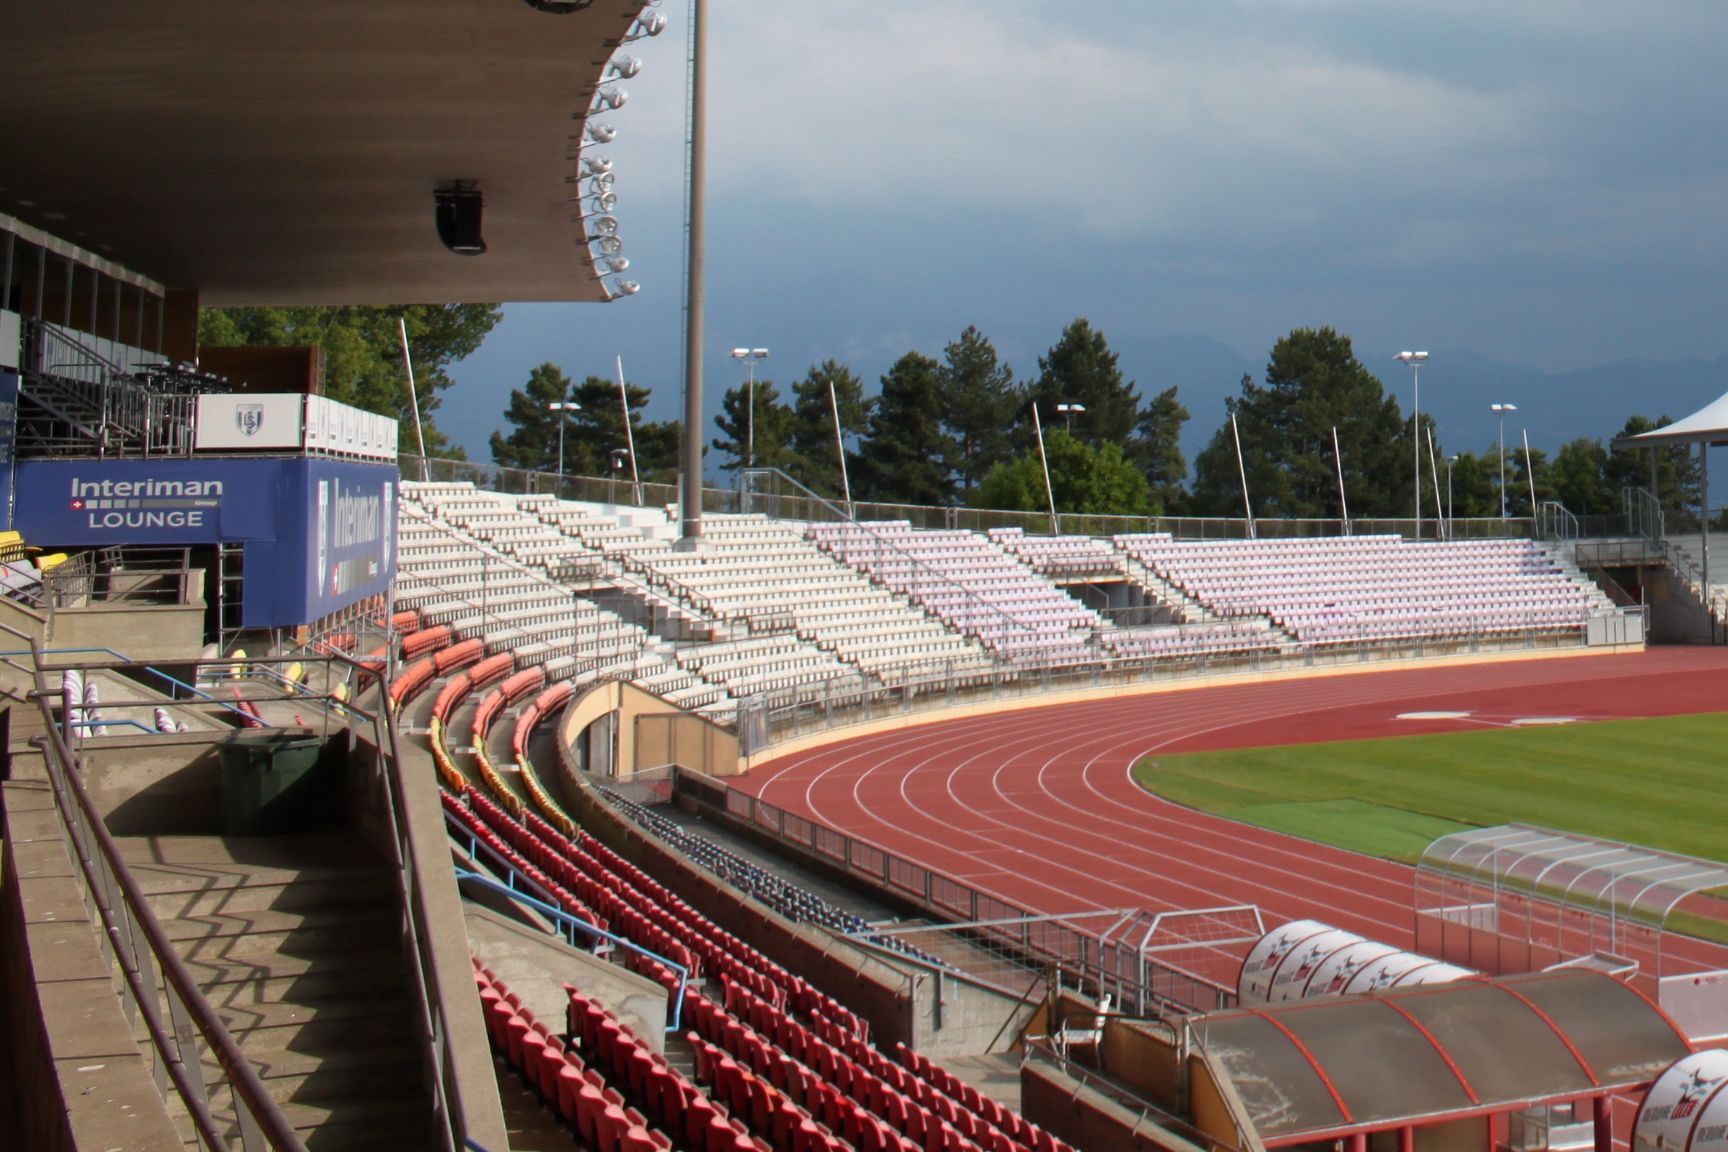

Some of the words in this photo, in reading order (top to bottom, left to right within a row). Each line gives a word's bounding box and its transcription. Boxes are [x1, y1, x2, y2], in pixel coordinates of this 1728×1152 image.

[71, 477, 224, 497] Interiman
[89, 511, 203, 529] LOUNGE
[334, 478, 380, 547] Interiman
